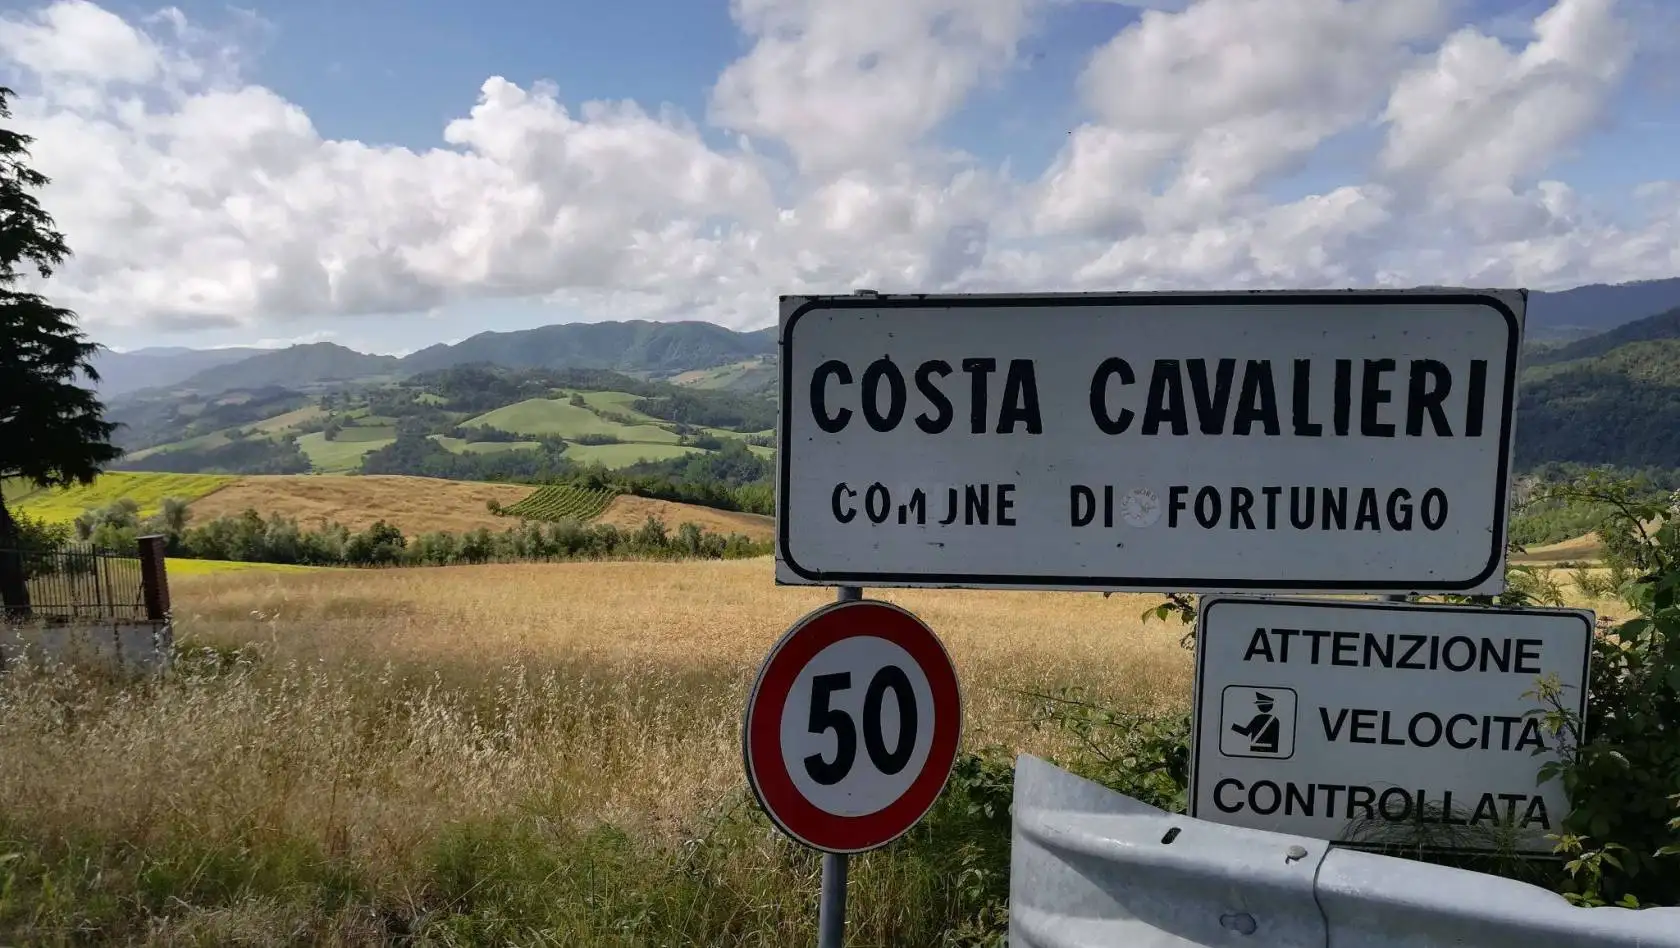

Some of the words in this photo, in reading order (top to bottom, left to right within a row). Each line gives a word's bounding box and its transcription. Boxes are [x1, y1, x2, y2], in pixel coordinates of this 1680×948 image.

[809, 356, 1043, 435] COSTA
[1089, 357, 1488, 438] CAVALIERI
[1070, 484, 1115, 528] DI
[1168, 485, 1450, 531] FORTUNAGO
[1243, 627, 1543, 674] ATTENZIONE
[803, 664, 918, 786] 50
[1318, 706, 1546, 752] VELOCITA
[1212, 777, 1551, 830] CONTROLLATA
